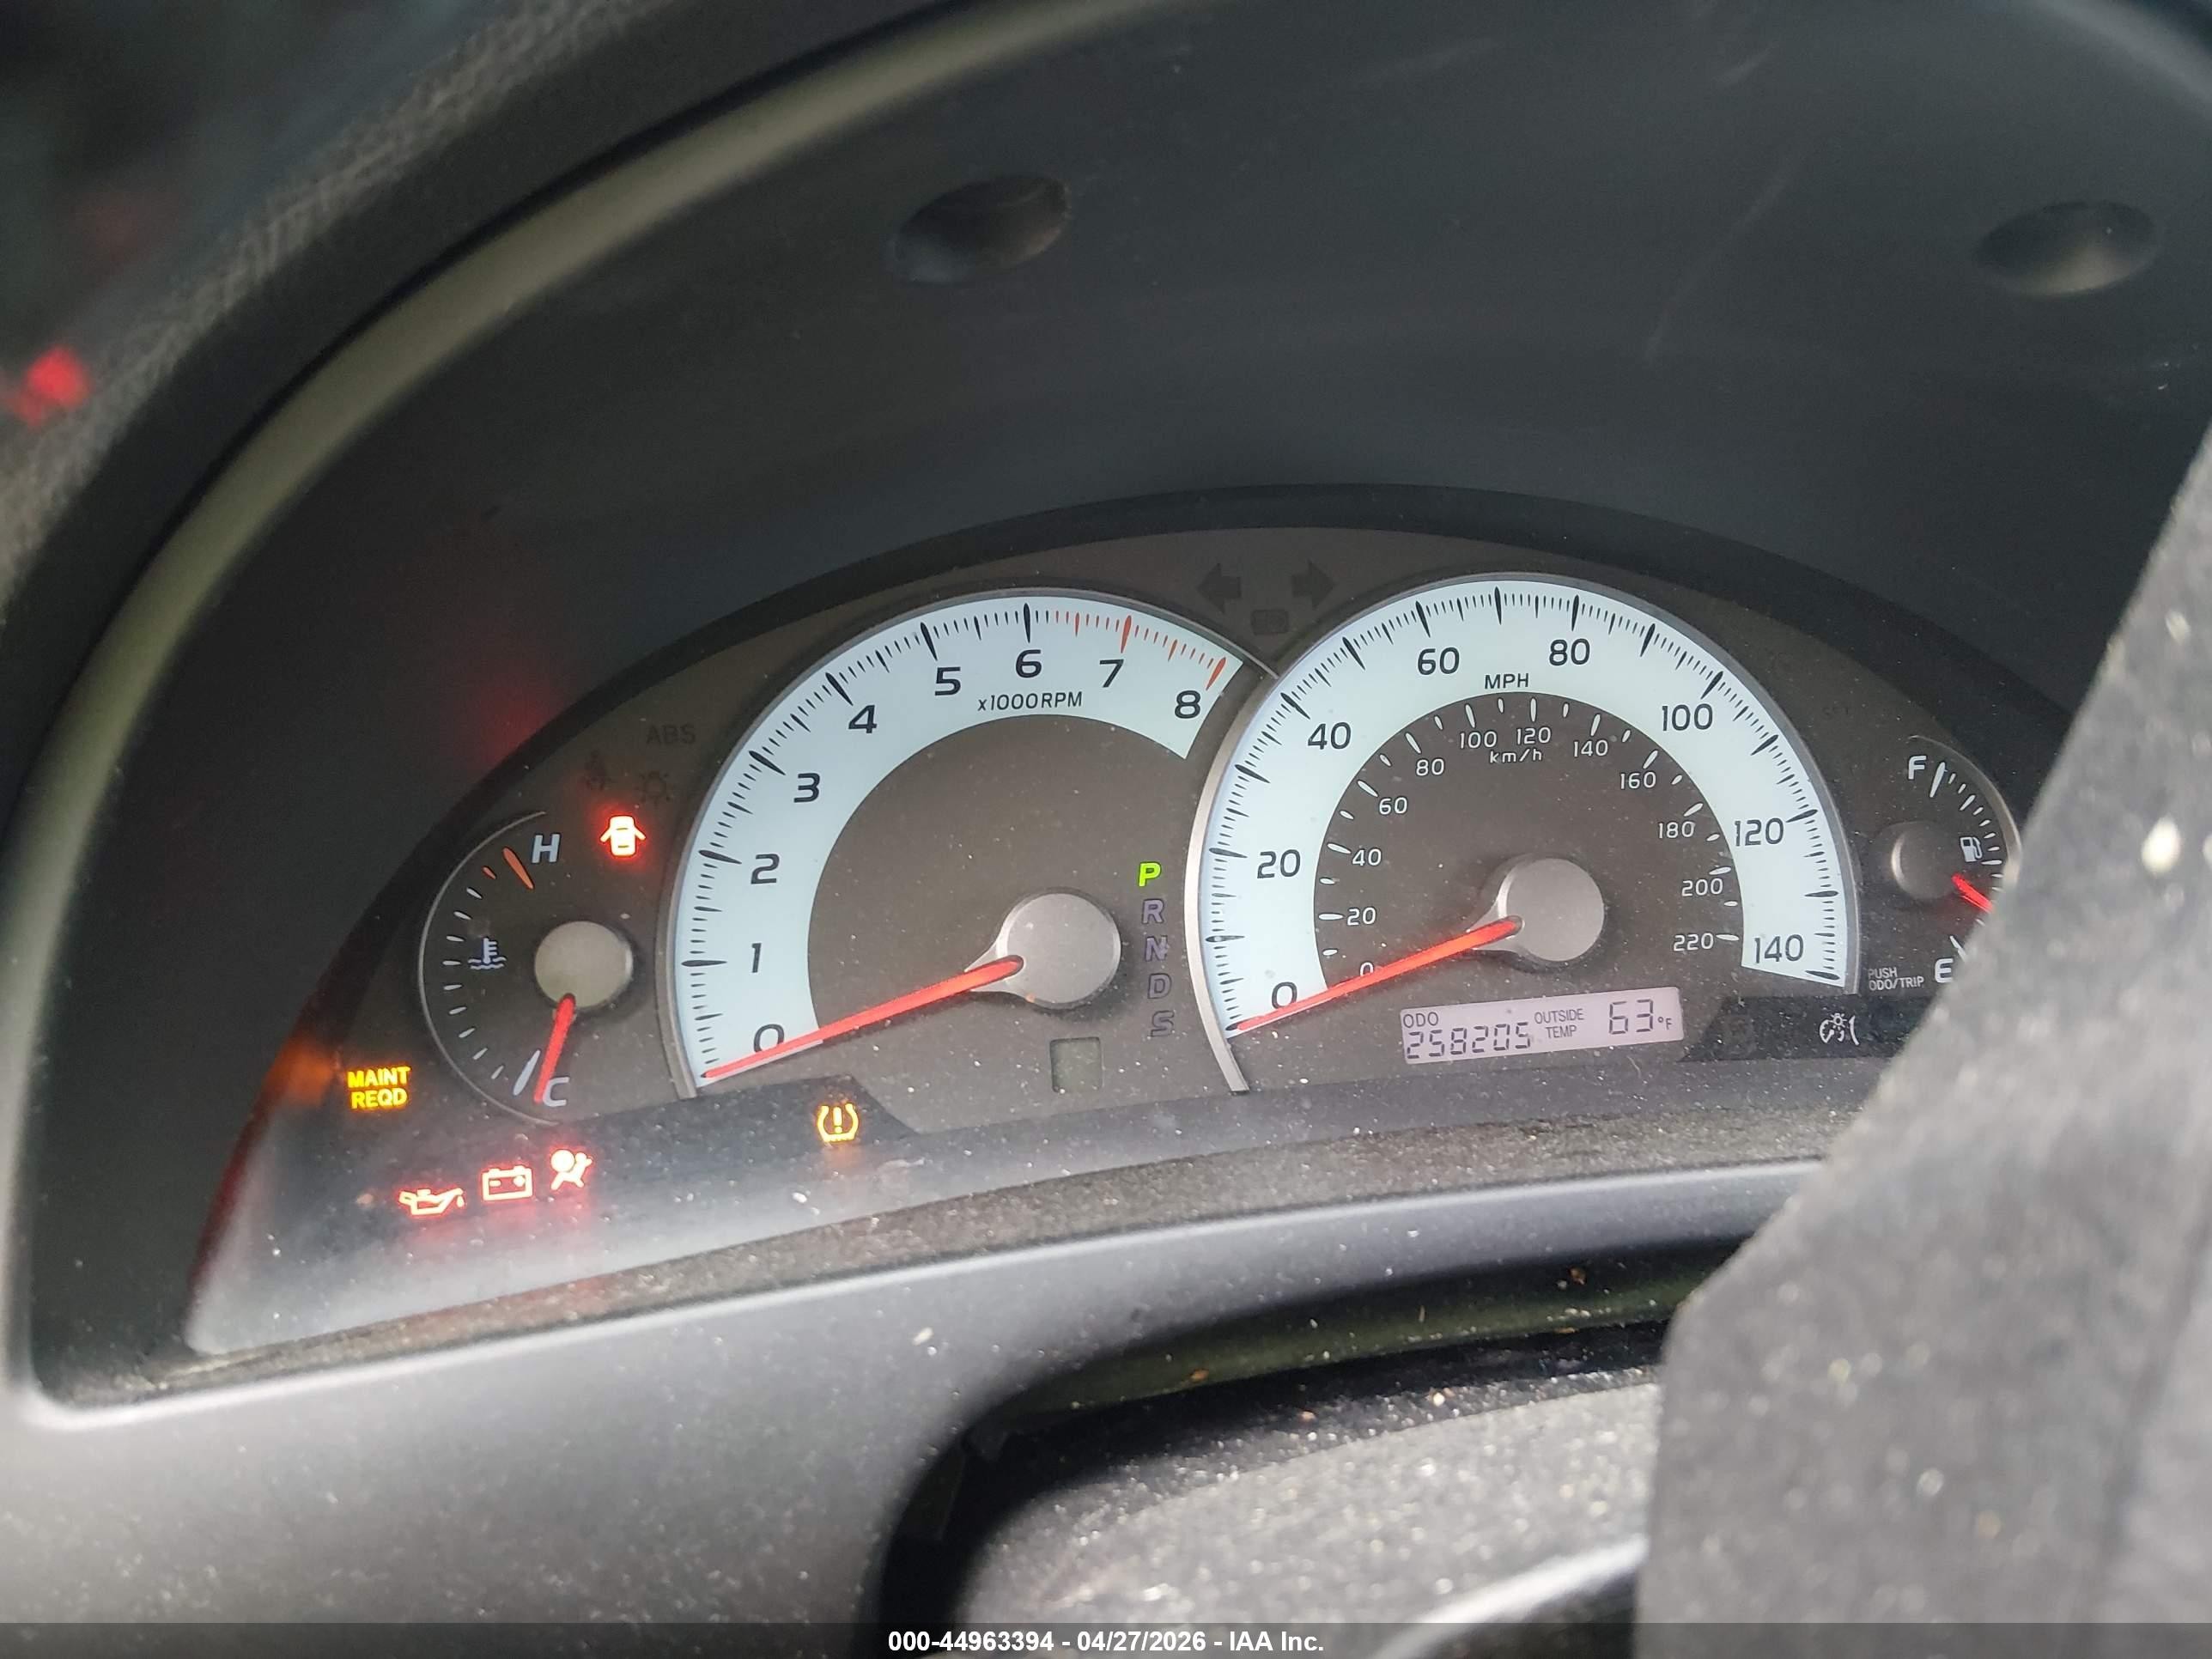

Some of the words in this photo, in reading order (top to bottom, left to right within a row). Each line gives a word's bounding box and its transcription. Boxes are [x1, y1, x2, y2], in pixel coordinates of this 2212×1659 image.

[1016, 649, 1042, 678] 6
[1417, 647, 1460, 675] 60
[1549, 638, 1590, 665] 80
[935, 667, 961, 696] 5
[1098, 659, 1124, 687] 7
[1485, 673, 1528, 689] MPH
[1175, 690, 1200, 718] 8
[848, 705, 878, 733] 4
[1662, 703, 1714, 731] 100
[646, 723, 696, 745] ABS
[1307, 722, 1351, 750] 40
[1461, 731, 1498, 750] 100
[1516, 726, 1552, 745] 120
[1490, 749, 1542, 763] km/h
[1574, 739, 1608, 757] 140
[1415, 758, 1445, 777] 80
[1908, 755, 1926, 780] F
[793, 774, 819, 802] 3
[1619, 771, 1656, 790] 160
[1378, 797, 1407, 816] 60
[1657, 820, 1694, 840] 180
[1734, 817, 1784, 848] 120
[532, 833, 561, 863] H
[1352, 848, 1382, 866] 40
[751, 854, 780, 884] 2
[1138, 861, 1162, 886] P
[1256, 850, 1301, 878] 20
[1681, 878, 1723, 897] 200
[1142, 899, 1164, 924] R
[1346, 907, 1376, 925] 20
[1144, 937, 1168, 962] N
[1673, 933, 1714, 951] 220
[1753, 934, 1804, 963] 140
[751, 942, 762, 973] 1
[1935, 957, 1954, 983] E
[1868, 967, 1898, 980] PUSH
[1869, 975, 1924, 991] ODO/TRIP
[1148, 974, 1171, 999] D
[1272, 981, 1297, 1009] 0
[1151, 1011, 1174, 1037] S
[1402, 1012, 1438, 1029] ODO
[1534, 1008, 1584, 1024] OUTSIDE
[1608, 999, 1653, 1035] 63
[754, 1024, 784, 1052] 0
[1407, 1022, 1531, 1060] 258205
[1545, 1025, 1577, 1040] TEMP
[347, 1066, 410, 1088] MAINT
[350, 1088, 409, 1109] REQD
[543, 1077, 569, 1107] C
